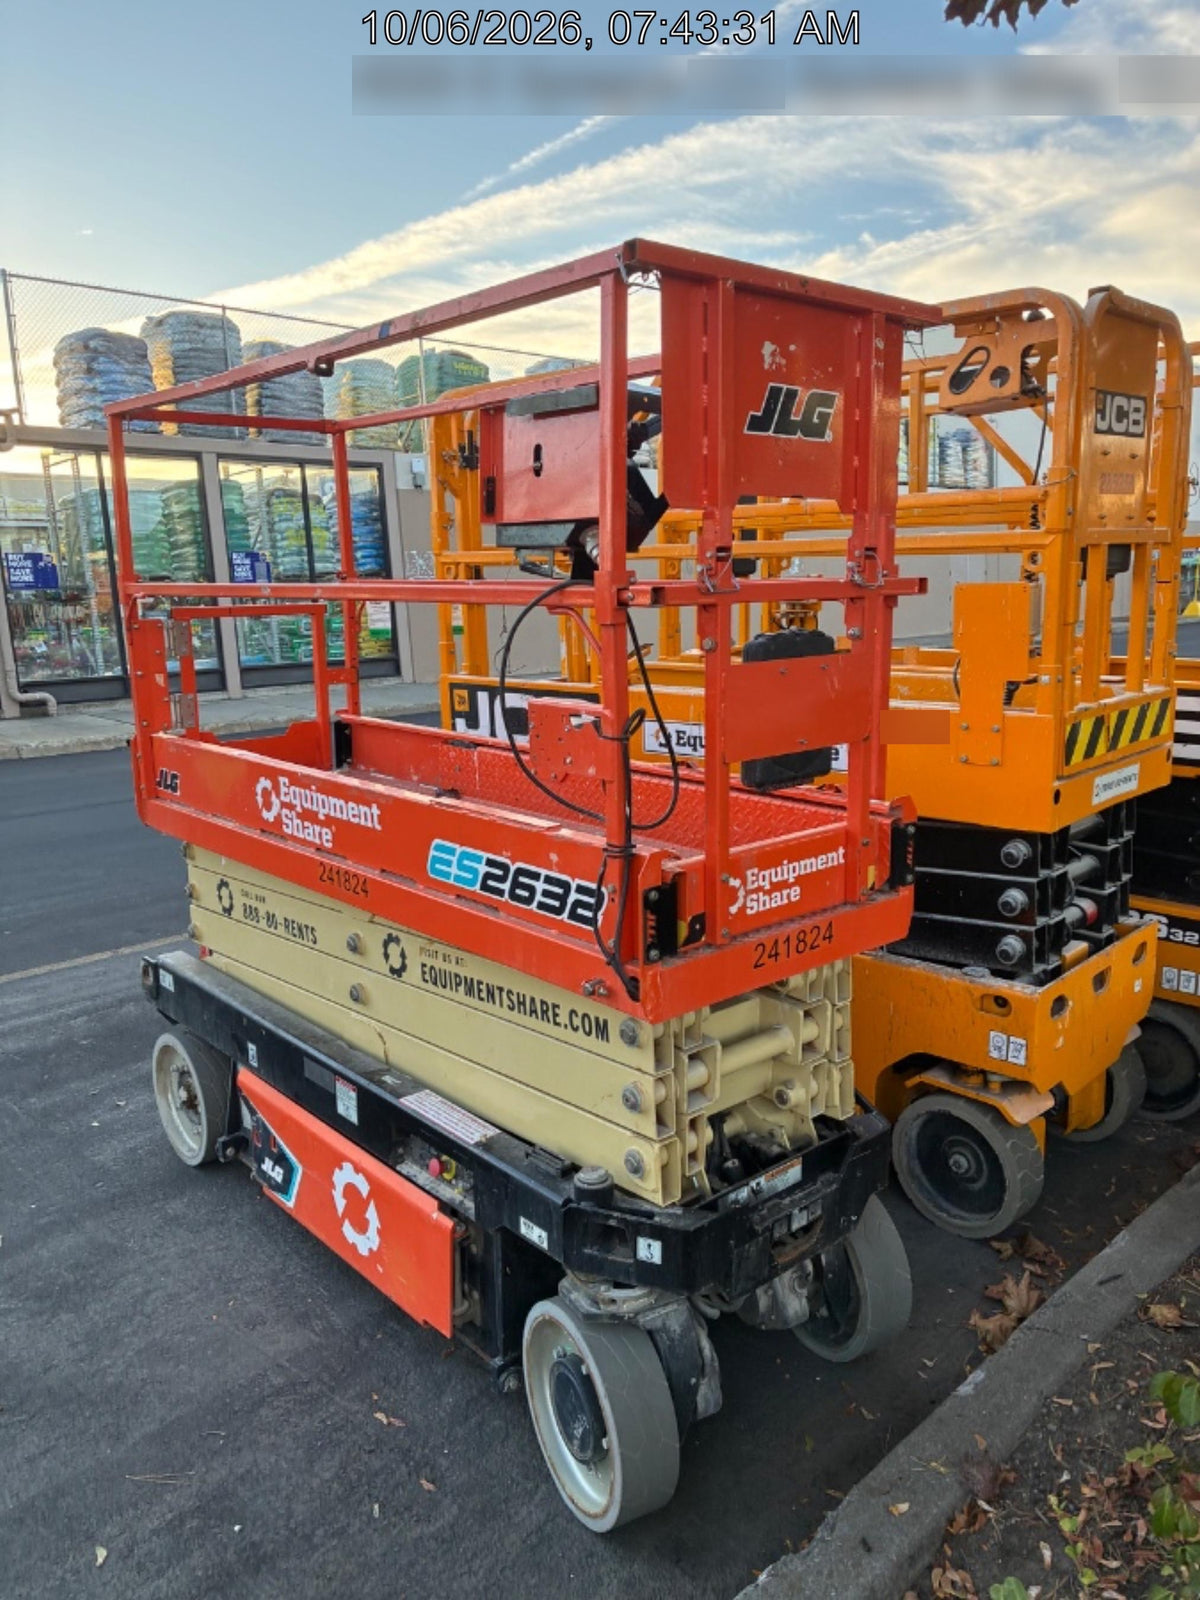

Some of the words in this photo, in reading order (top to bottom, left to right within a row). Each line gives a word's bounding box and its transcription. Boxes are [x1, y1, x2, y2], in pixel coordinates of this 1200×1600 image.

[743, 382, 839, 442] JLG
[1096, 393, 1146, 434] JCB
[454, 689, 529, 743] JC
[156, 767, 181, 796] JLG
[277, 775, 382, 831] Equipment
[280, 809, 334, 849] Share
[319, 862, 369, 898] 241824
[427, 838, 608, 930] ES2632
[746, 846, 845, 891] Equipment
[746, 886, 801, 915] Share
[242, 902, 318, 945] 888-80-RENTS
[753, 920, 834, 970] 241824
[420, 962, 611, 1043] EQUIPMENTSHARE.COM
[260, 1156, 284, 1184] JLG
